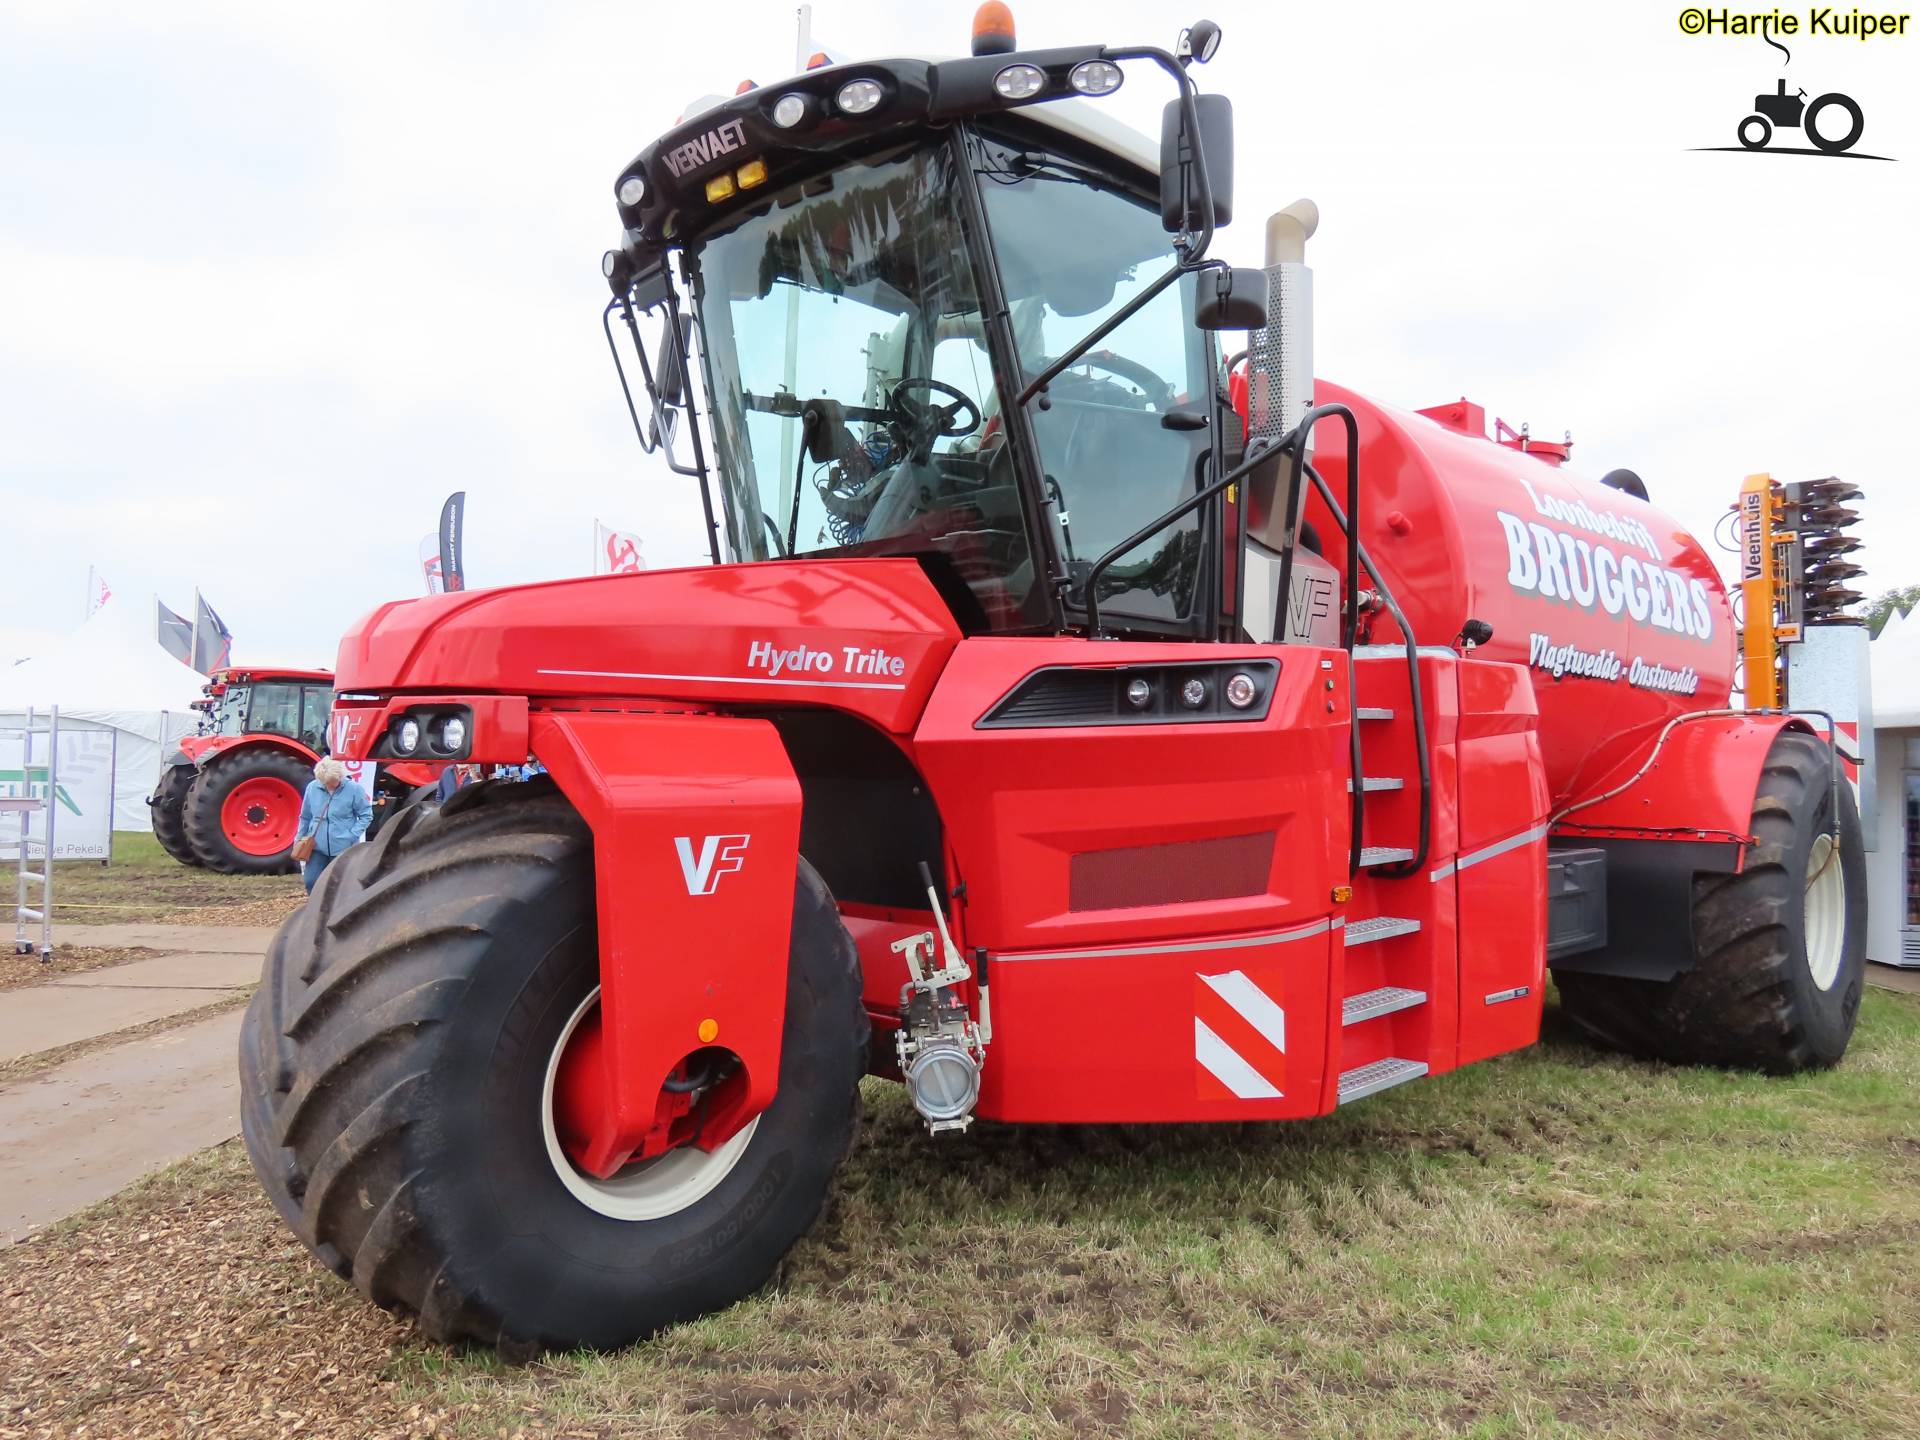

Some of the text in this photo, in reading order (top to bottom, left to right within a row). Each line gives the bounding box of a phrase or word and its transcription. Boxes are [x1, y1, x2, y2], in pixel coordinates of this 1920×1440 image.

[662, 118, 747, 178] VERVAET
[1520, 479, 1662, 561] Loonbedrijf
[1744, 493, 1762, 580] Veenhuis
[1497, 511, 1713, 640] BRUGGERS
[748, 641, 905, 677] Hydro Trike
[1529, 633, 1621, 678] Vlagtwedde
[1629, 656, 1699, 695] Onstwedde
[336, 714, 362, 754] VF
[67, 844, 103, 854] Pekela
[674, 834, 750, 895] VF
